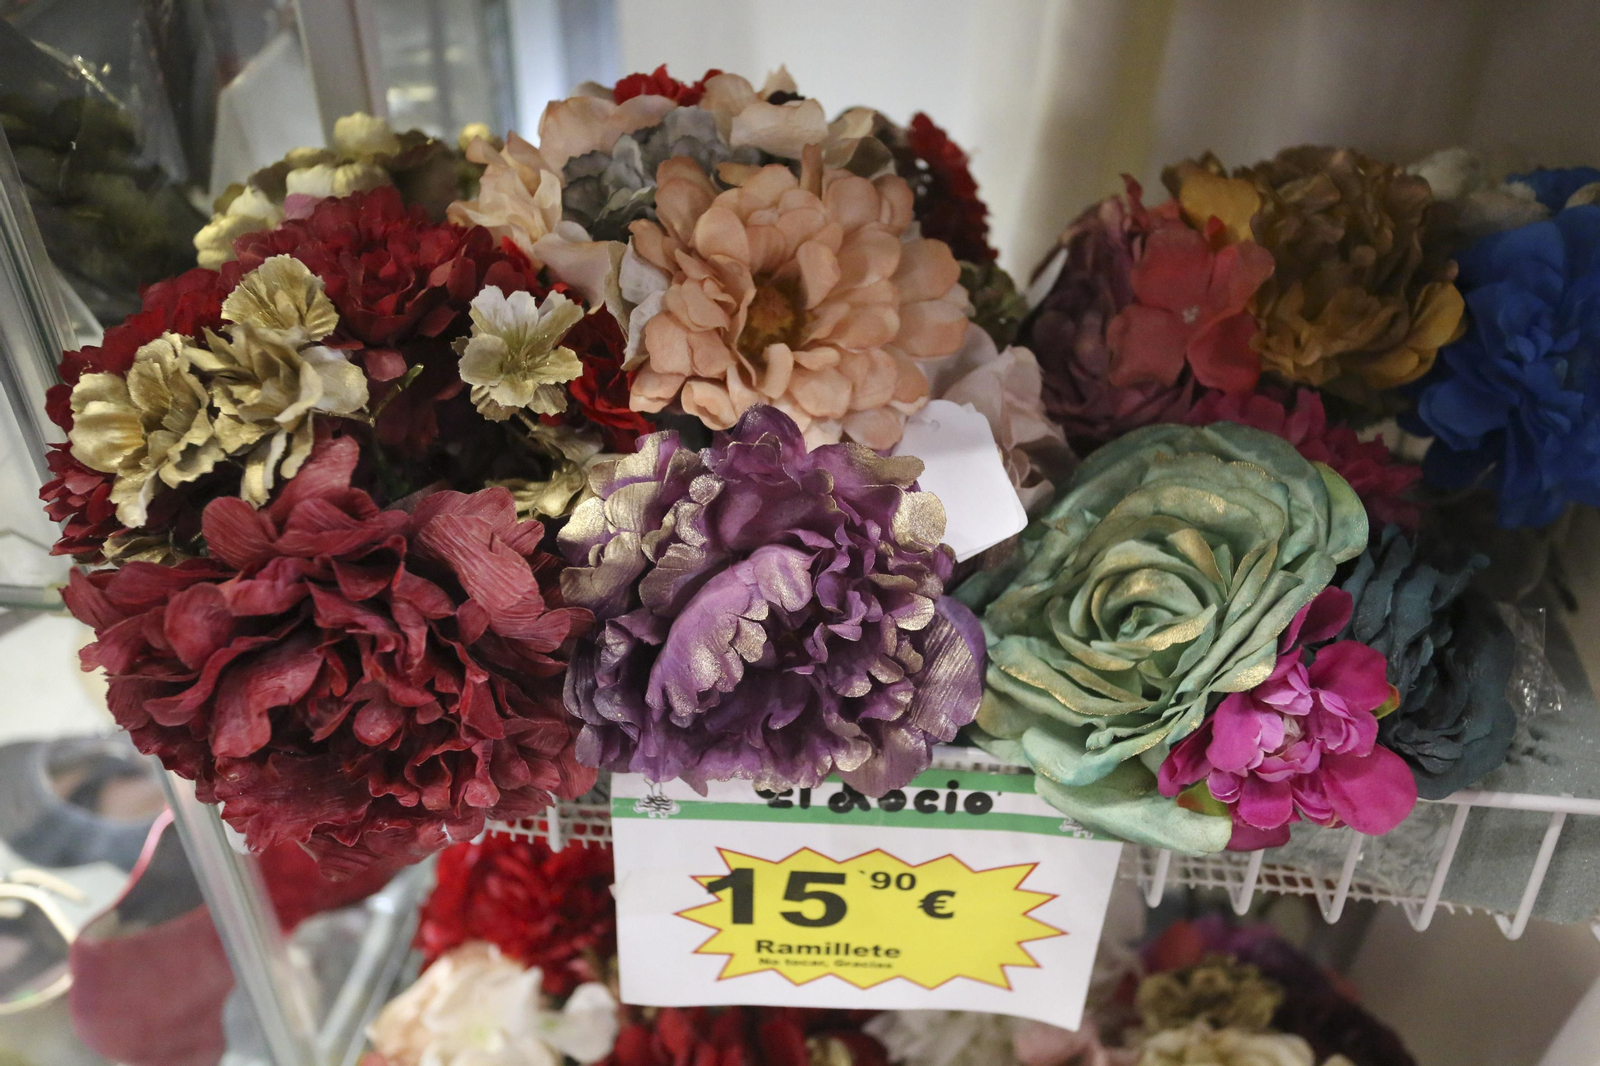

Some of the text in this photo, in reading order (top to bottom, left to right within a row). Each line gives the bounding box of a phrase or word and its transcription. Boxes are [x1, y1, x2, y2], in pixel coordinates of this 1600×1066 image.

[755, 940, 901, 958] Ramillete
[758, 957, 779, 966] No
[834, 959, 893, 969] Gracias
